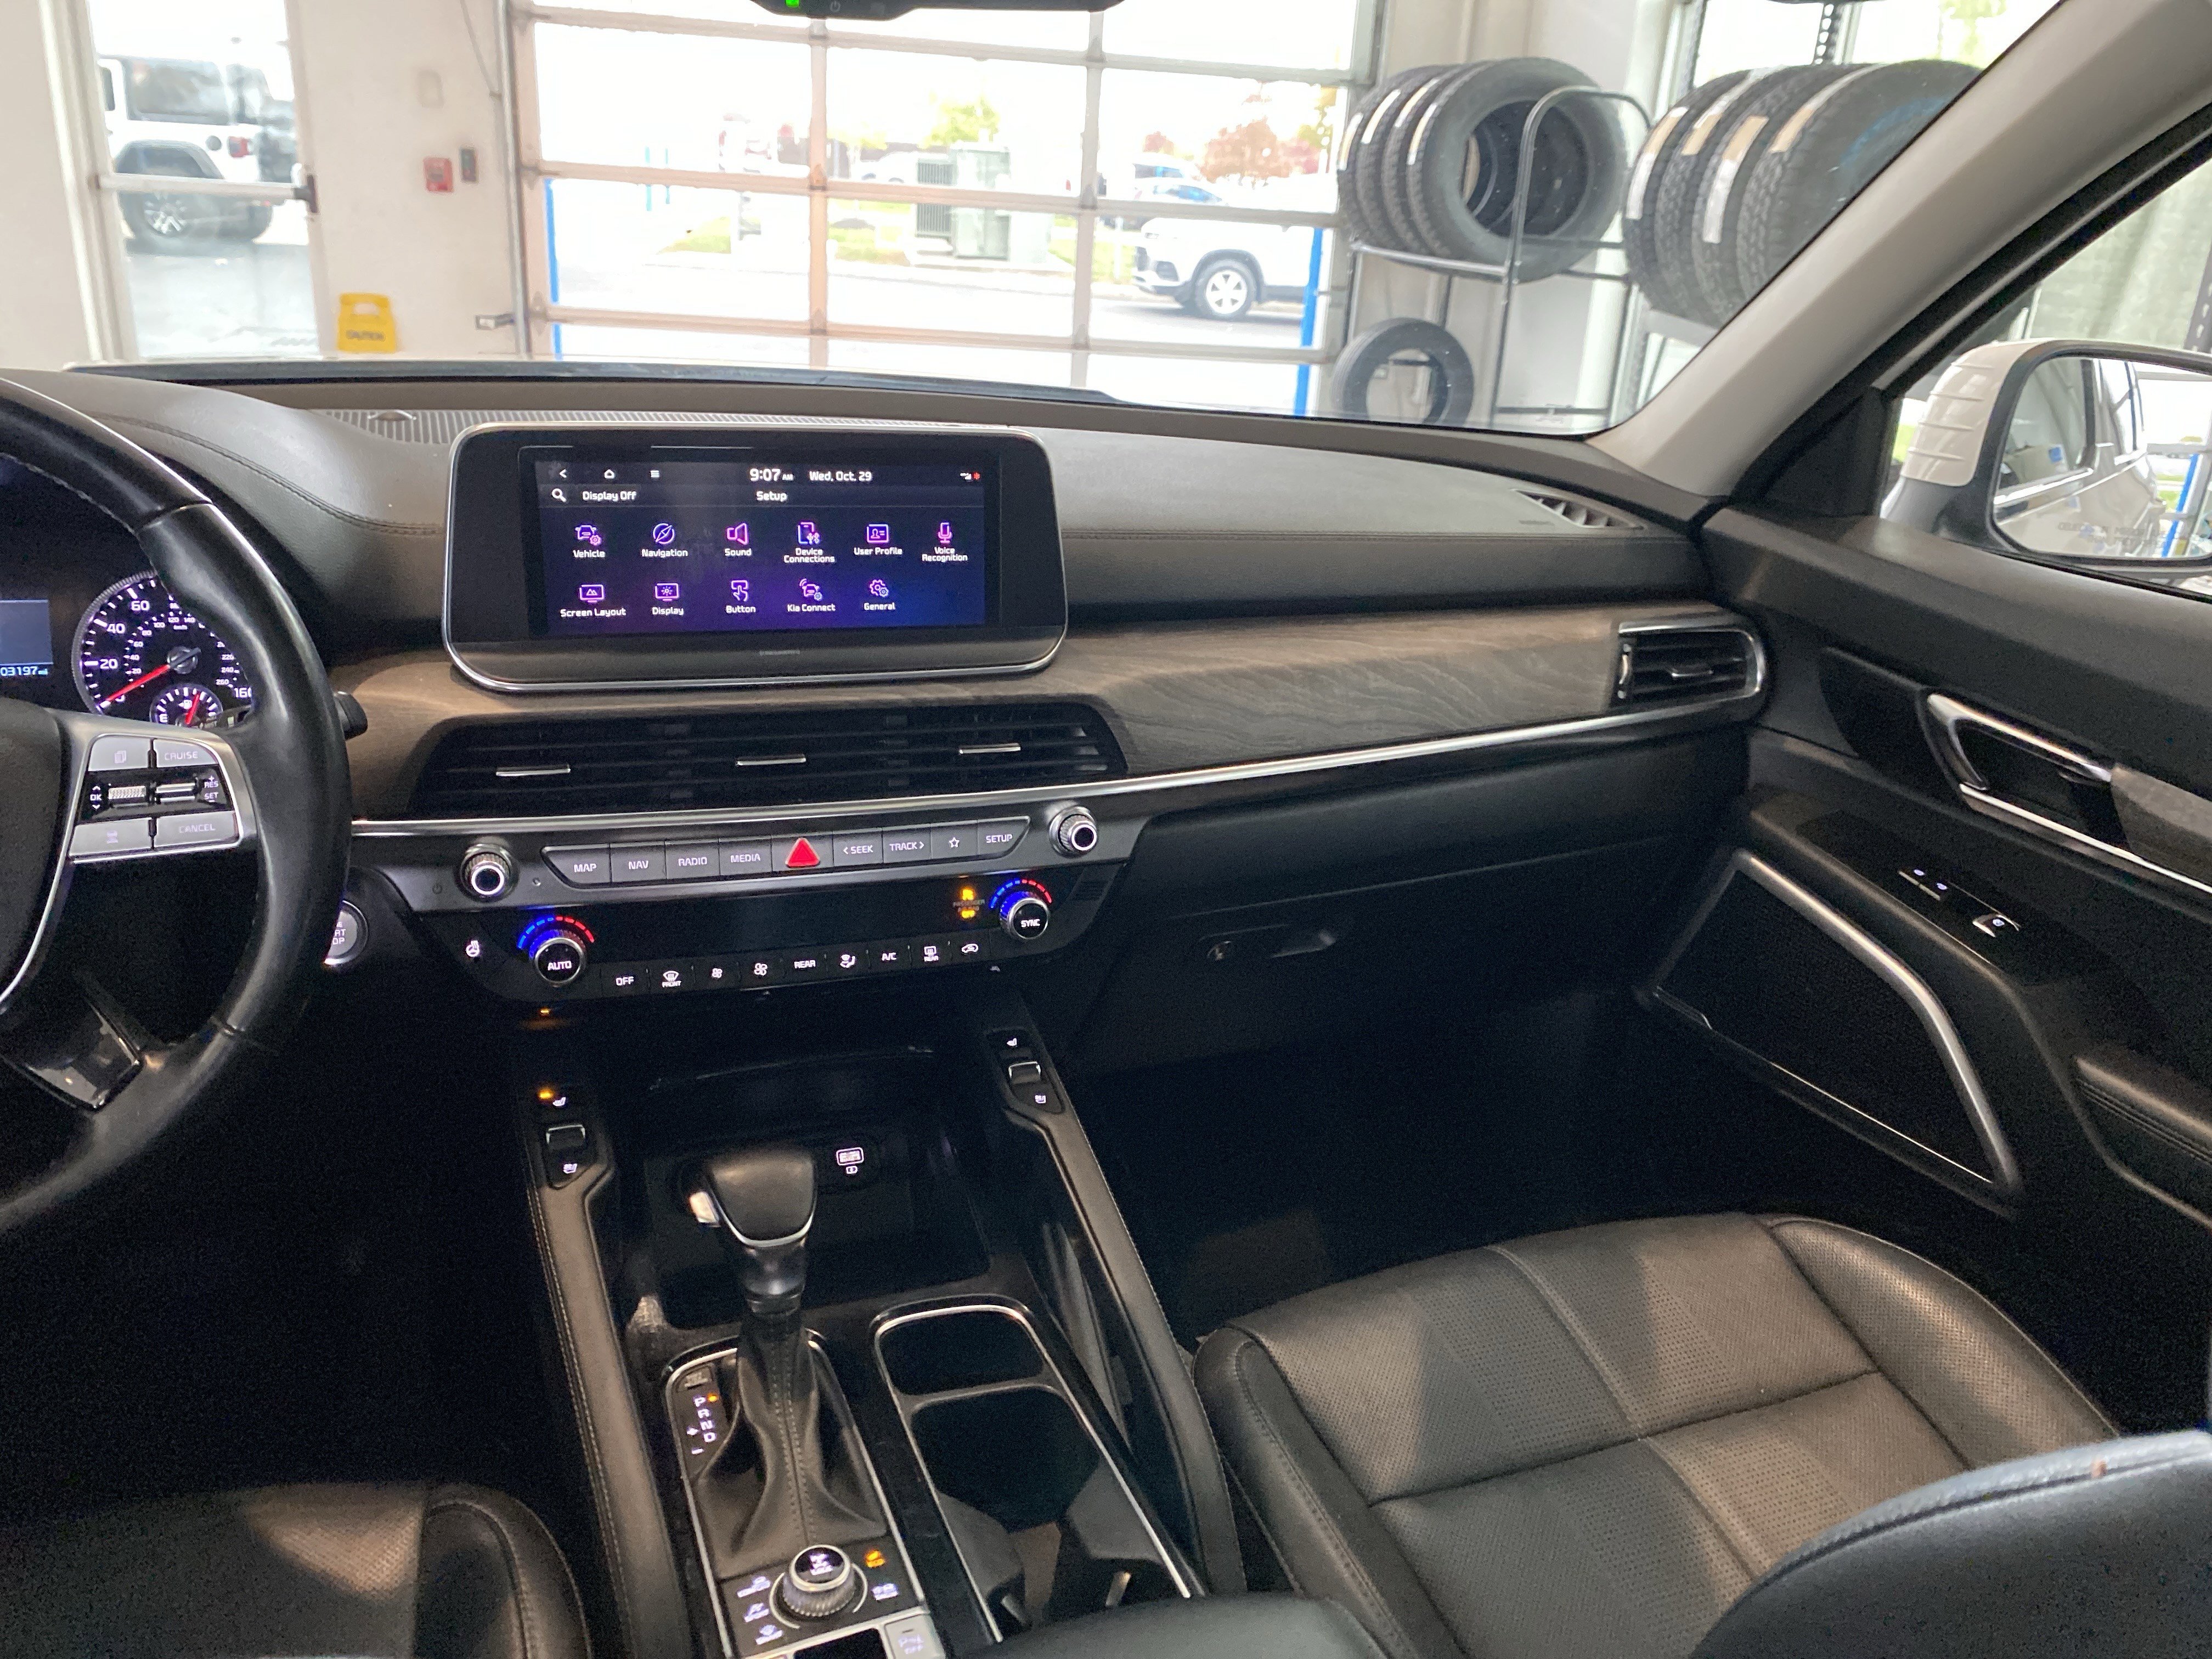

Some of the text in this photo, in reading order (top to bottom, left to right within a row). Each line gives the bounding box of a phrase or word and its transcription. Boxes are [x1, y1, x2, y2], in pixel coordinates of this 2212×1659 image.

[749, 468, 781, 482] 9:07
[836, 471, 857, 481] Oct.
[859, 471, 872, 481] 29
[582, 490, 637, 503] Display Off
[756, 492, 788, 502] Setup
[573, 549, 606, 558] Vehicle
[641, 549, 688, 558] Navigation
[725, 548, 752, 556] Sound
[795, 548, 823, 556] Device
[875, 547, 902, 555] Profile
[783, 555, 836, 563] Connections
[922, 554, 968, 562] Recognition
[131, 600, 150, 611] 60
[726, 605, 756, 613] Button
[787, 603, 836, 612] Kia Connect
[864, 602, 895, 611] General
[560, 607, 626, 617] Screen Layout
[652, 607, 684, 616] Display
[107, 623, 126, 634] 40
[100, 658, 118, 669] 20
[165, 751, 199, 761] CRUISE
[179, 823, 216, 833] CANCEL
[986, 833, 1013, 844] SETUP
[850, 845, 873, 854] SEEK
[889, 842, 918, 851] TRACK
[678, 856, 708, 867] RADIO
[730, 853, 761, 864] MEDIA
[573, 862, 597, 873] MAP
[628, 860, 649, 870] NAV
[1020, 918, 1041, 928] SYNC
[881, 952, 897, 962] A/C
[548, 961, 572, 970] AUTO
[794, 959, 816, 969] REAR
[616, 976, 634, 986] OFF
[693, 1397, 706, 1407] P
[701, 1420, 713, 1431] N
[703, 1432, 716, 1443] D
